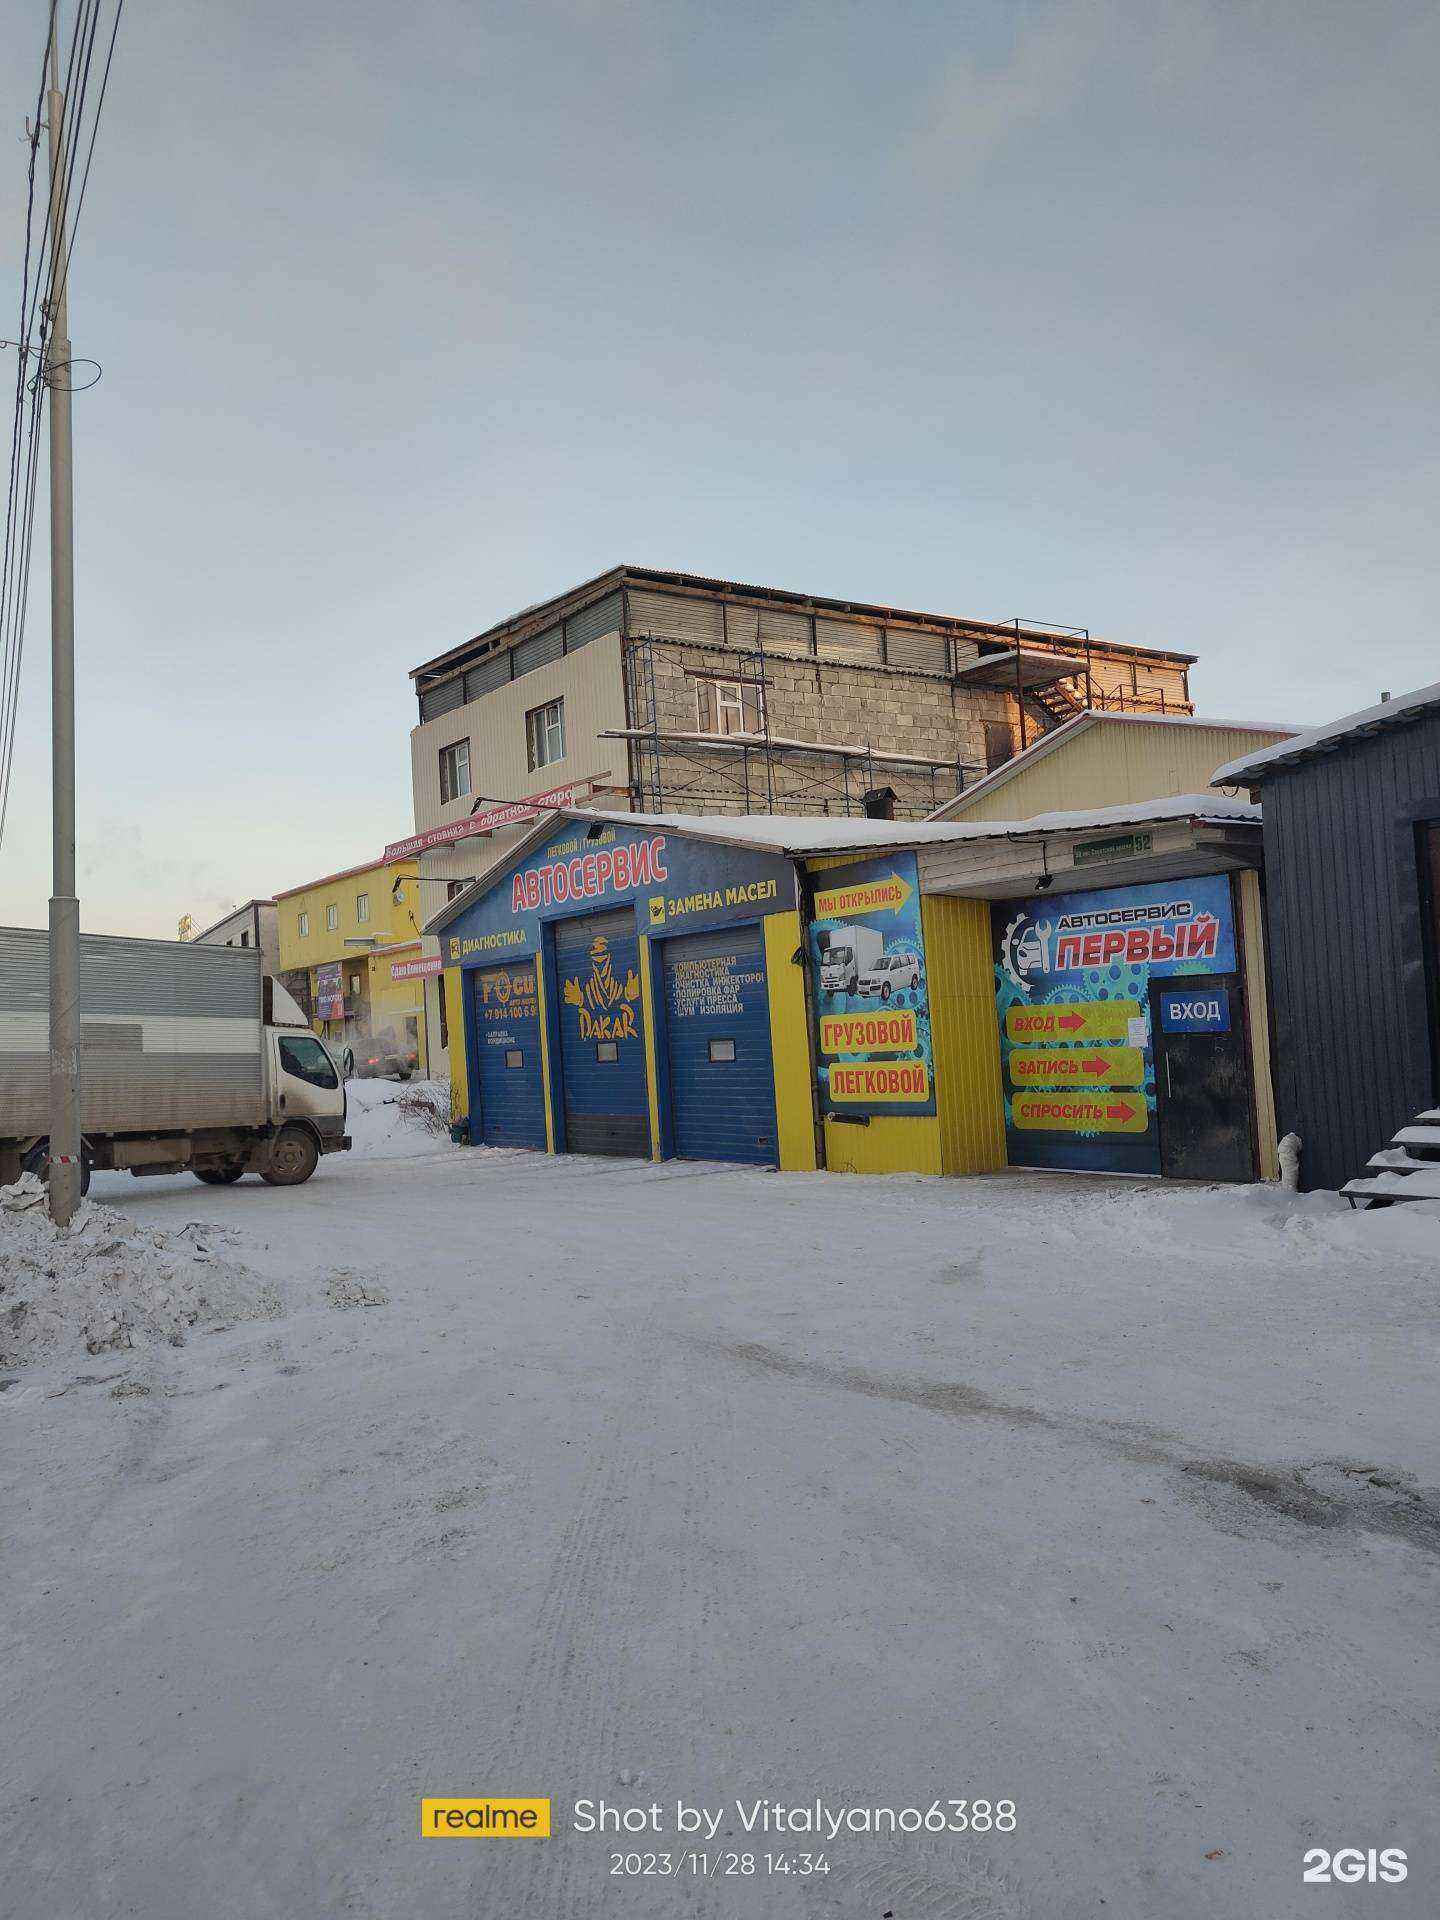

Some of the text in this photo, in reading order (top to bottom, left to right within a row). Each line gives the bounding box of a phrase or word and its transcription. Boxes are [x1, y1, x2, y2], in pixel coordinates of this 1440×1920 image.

[385, 839, 423, 857] Большая
[426, 826, 465, 844] стоянка
[512, 836, 668, 913] АВТОСЕРВИС
[668, 880, 777, 916] ЗАМЕНА МАСЕЛ
[818, 885, 902, 913] МЫ ОТКРЫЛИСЬ
[1058, 900, 1194, 930] АВТОСЕРВИС
[462, 928, 527, 955] ДИАГНОСТИКА
[1056, 912, 1219, 970] ПЕРВЫЙ
[674, 956, 737, 972] КОМПЬЮТЕРНАЯ
[675, 967, 730, 981] ДИАГНОСТИКА
[675, 979, 710, 989] ОЧИСТКА
[675, 984, 740, 998] ПОЛИРОВКА ФАР
[676, 995, 739, 1008] УСЛУГИ ПРЕССА
[677, 1003, 744, 1016] ШУМ ИЗОЛЯЦИЯ
[1169, 1001, 1221, 1021] ВХОД
[578, 1003, 639, 1041] DAKAR
[823, 1014, 913, 1047] ГРУЗОВОЙ
[1013, 1015, 1056, 1032] ВХОД
[1017, 1060, 1078, 1075] ЗАПИСЬ
[833, 1065, 925, 1094] ЛЕГКОВОЙ
[1020, 1103, 1104, 1120] СПРОСИТЬ
